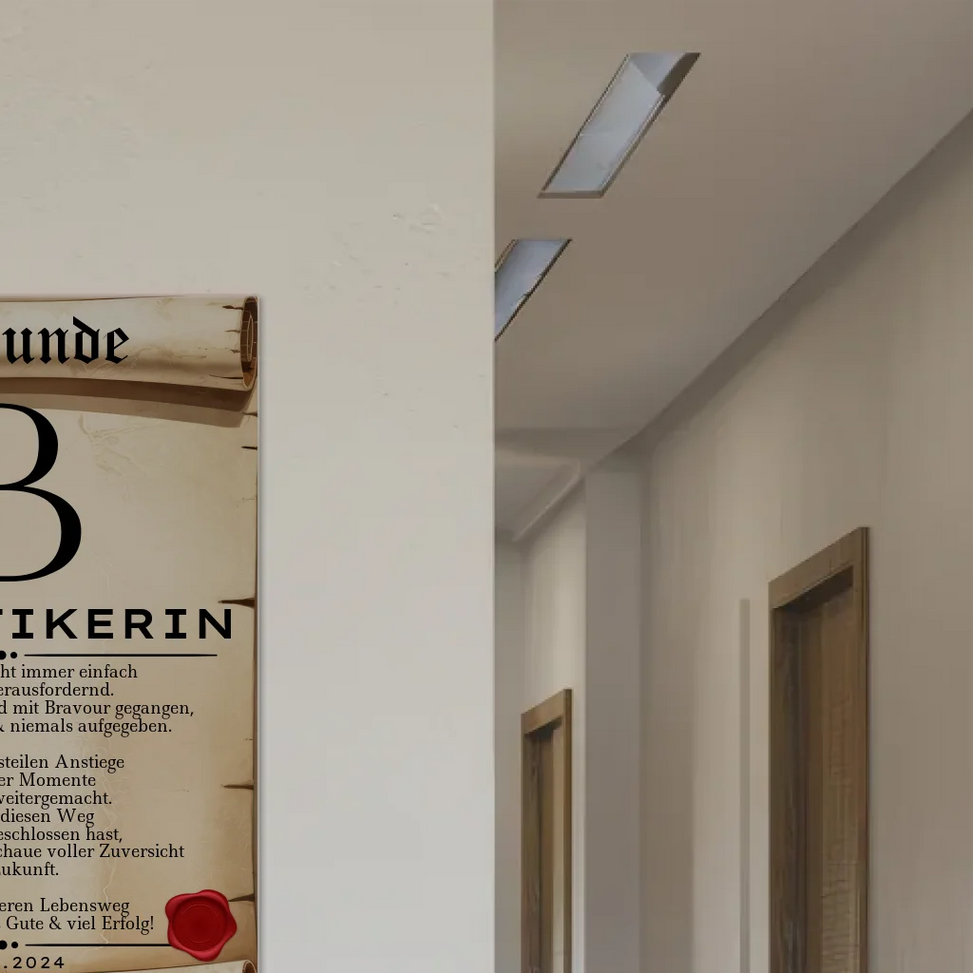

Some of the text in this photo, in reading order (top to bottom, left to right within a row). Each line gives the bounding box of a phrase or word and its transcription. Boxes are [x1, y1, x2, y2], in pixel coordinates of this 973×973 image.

[22, 664, 74, 678] immer
[80, 664, 137, 678] einfach
[13, 700, 39, 714] mit
[45, 700, 111, 714] Bravour
[115, 705, 193, 720] gegangen,
[11, 718, 72, 732] niemals
[79, 718, 171, 737] aufgegeben.
[55, 754, 124, 774] Anstiege
[20, 772, 95, 786] Momente
[1, 808, 50, 822] diesen
[57, 808, 94, 828] Weg
[86, 826, 122, 843] hast,
[48, 844, 94, 857] voller
[100, 843, 184, 857] Zuversicht
[41, 898, 129, 917] Lebensweg
[7, 916, 43, 929] Gute
[49, 916, 61, 929] &
[67, 916, 95, 929] viel
[102, 915, 153, 935] Erfolg!
